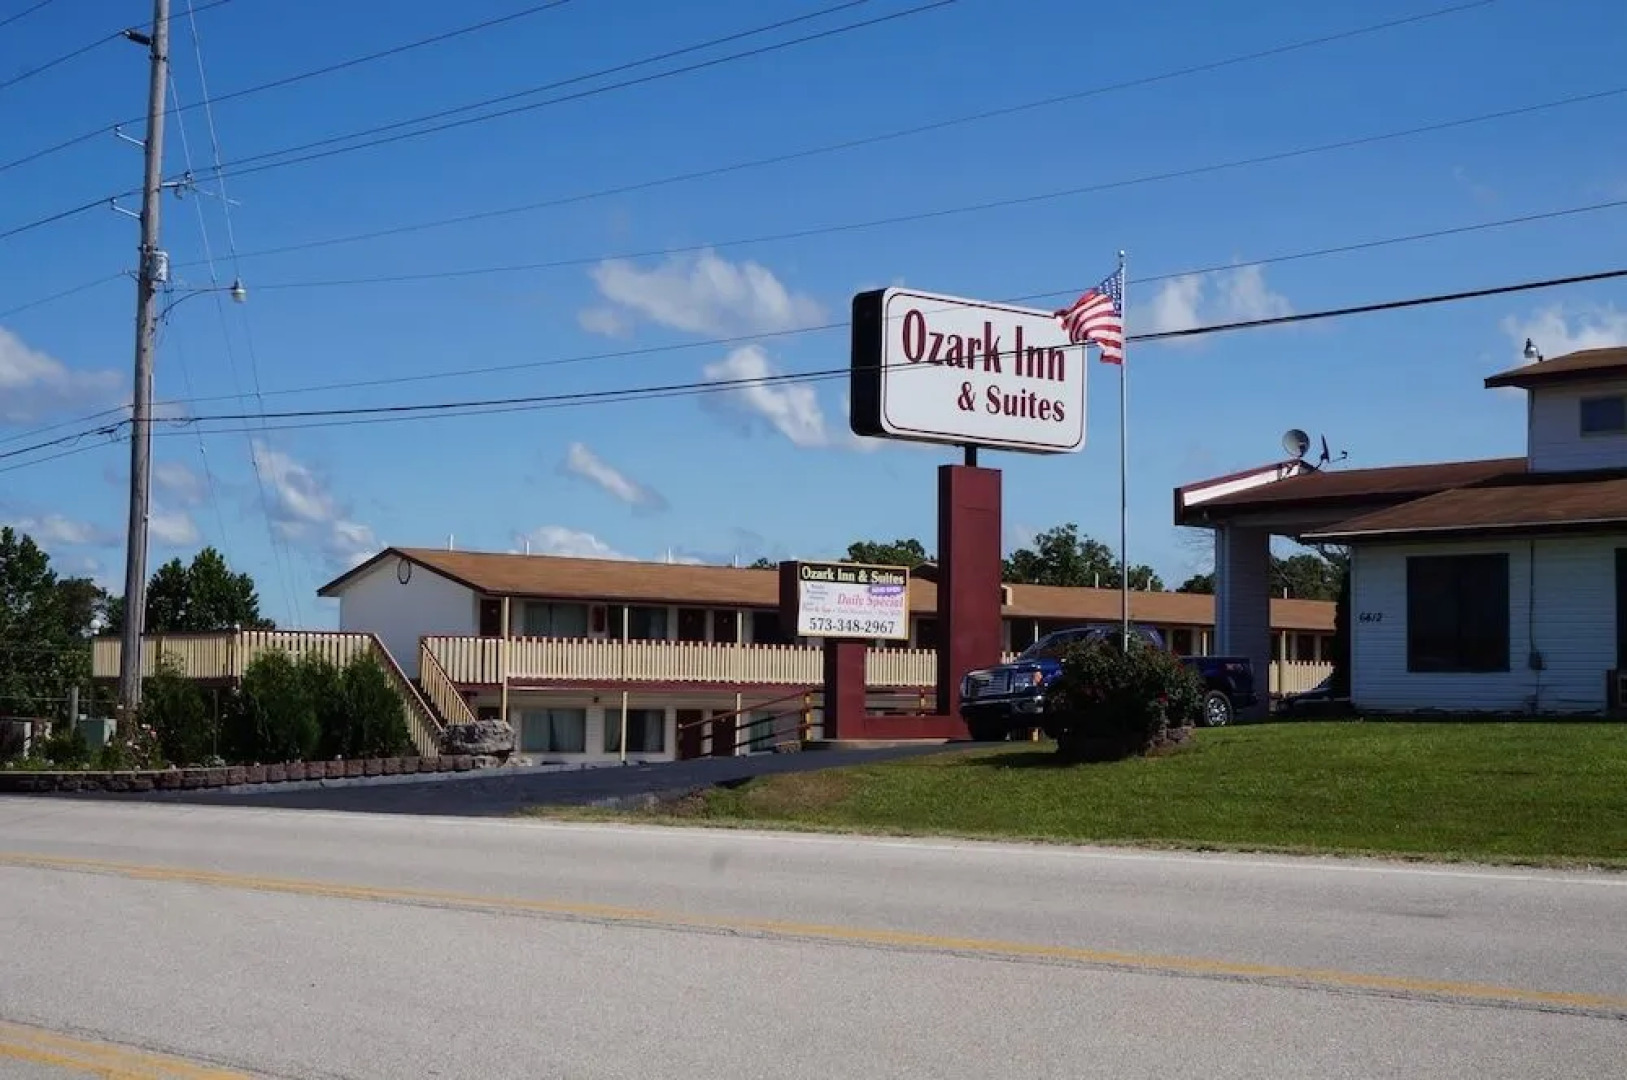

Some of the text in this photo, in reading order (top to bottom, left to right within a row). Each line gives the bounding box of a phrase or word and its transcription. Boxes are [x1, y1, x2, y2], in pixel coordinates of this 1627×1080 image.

[902, 309, 1065, 381] Ozark Inn
[957, 381, 1065, 422] & Suites
[801, 566, 904, 584] Ozark Inn & Suites
[837, 593, 864, 605] Daily
[810, 617, 895, 633] 573-348-2967
